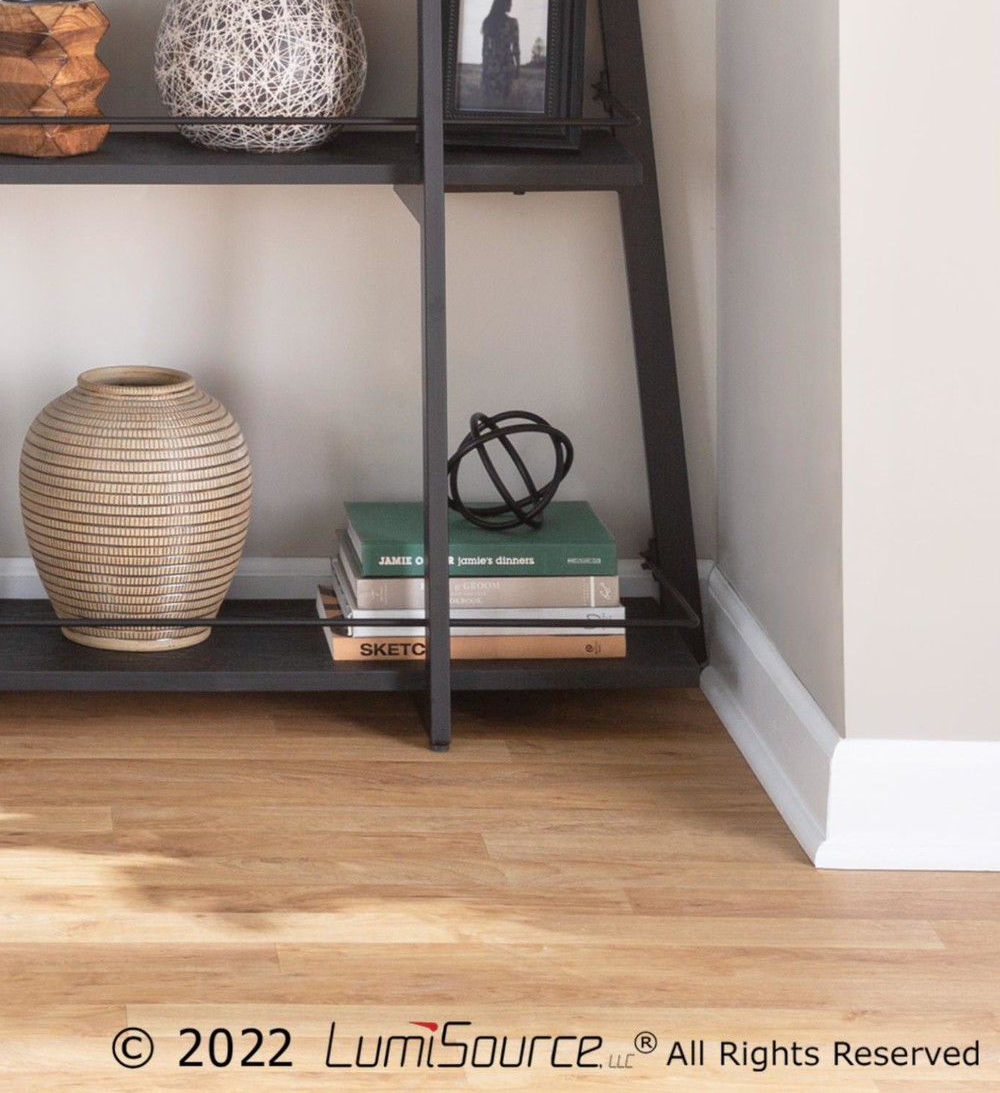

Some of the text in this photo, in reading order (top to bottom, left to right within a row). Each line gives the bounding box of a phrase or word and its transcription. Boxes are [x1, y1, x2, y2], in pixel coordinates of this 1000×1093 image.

[378, 556, 412, 565] JAMIE
[457, 556, 493, 567] jamie's
[495, 556, 535, 565] dinners
[463, 581, 501, 590] GROOM
[360, 642, 426, 657] SKETC
